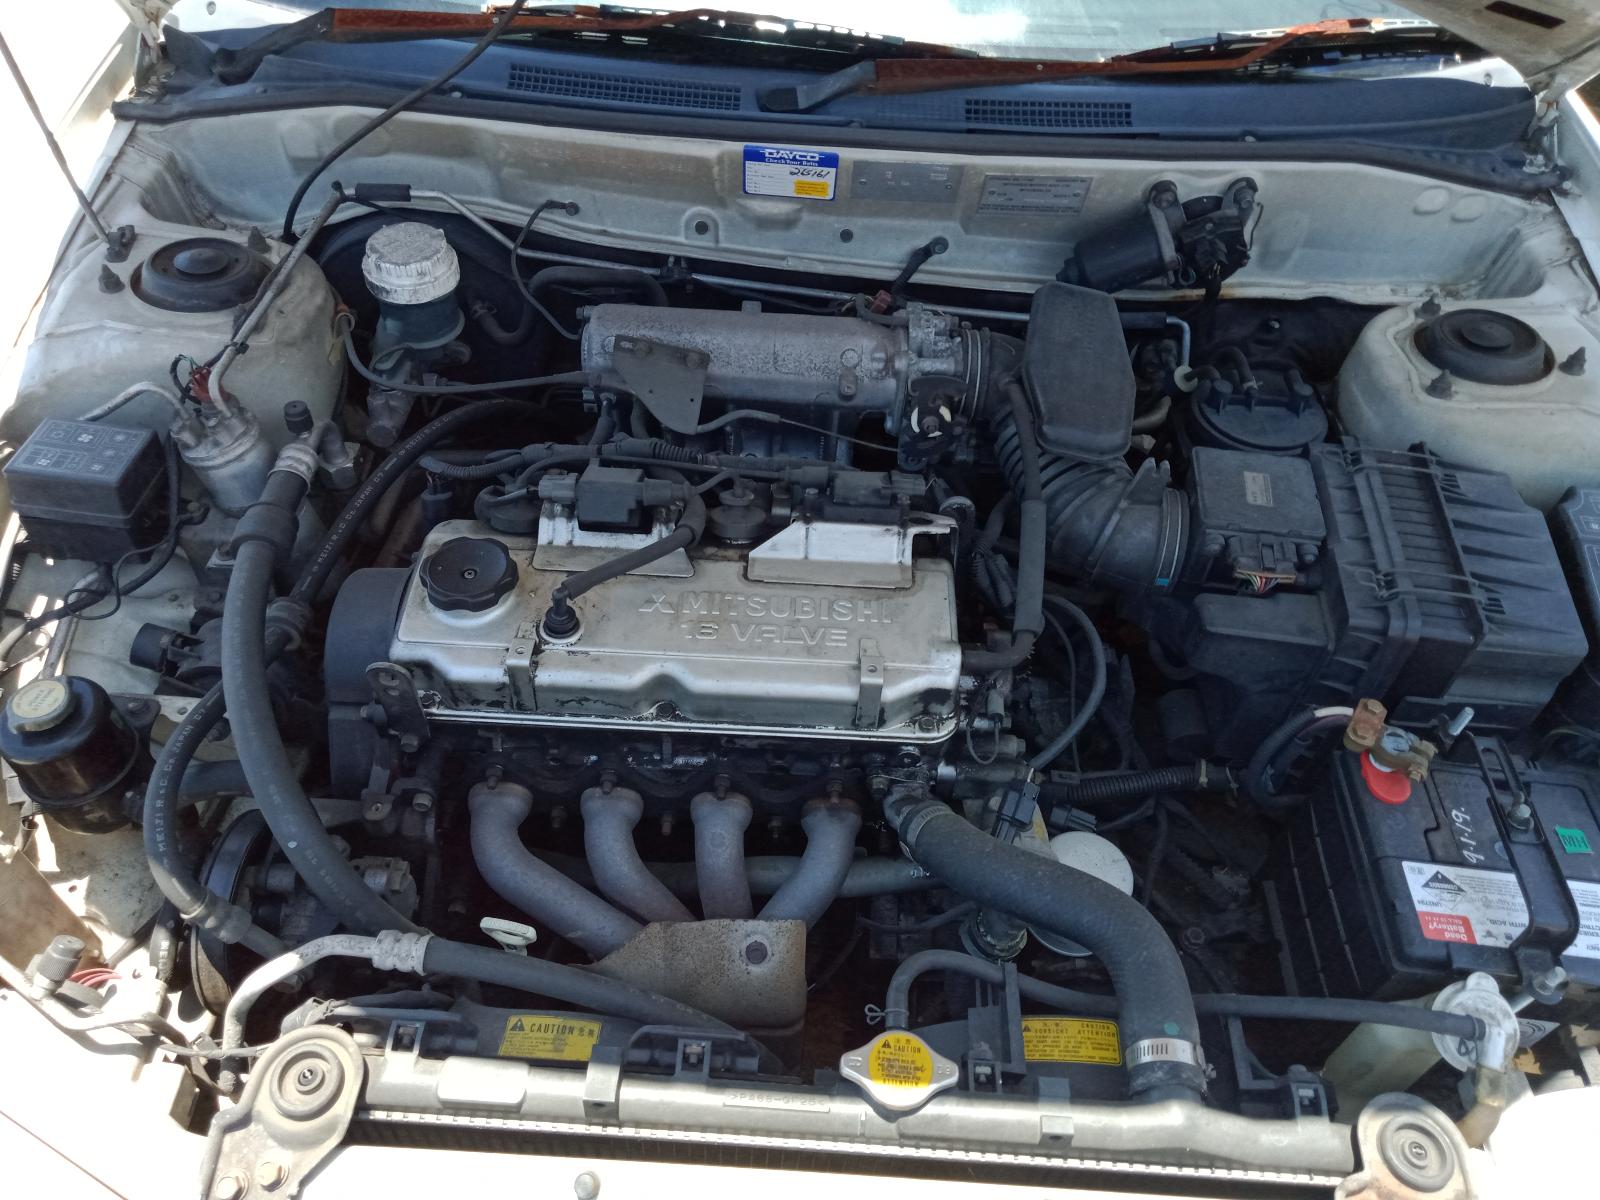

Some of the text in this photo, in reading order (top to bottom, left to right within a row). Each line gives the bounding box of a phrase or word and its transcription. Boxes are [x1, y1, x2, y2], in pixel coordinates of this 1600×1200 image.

[764, 148, 820, 161] DAYCO
[765, 157, 787, 165] Check
[355, 485, 374, 509] JAPAN
[680, 591, 893, 624] MITSUBISHI
[731, 623, 848, 648] VALVE
[175, 724, 195, 754] JAPAN
[1428, 922, 1465, 934] Battery?
[1444, 931, 1467, 941] Dead
[529, 1023, 575, 1036] CAUTION
[1081, 1023, 1111, 1031] CAUTION
[1077, 1029, 1116, 1038] ATTENTION
[893, 1044, 921, 1054] CAUTION
